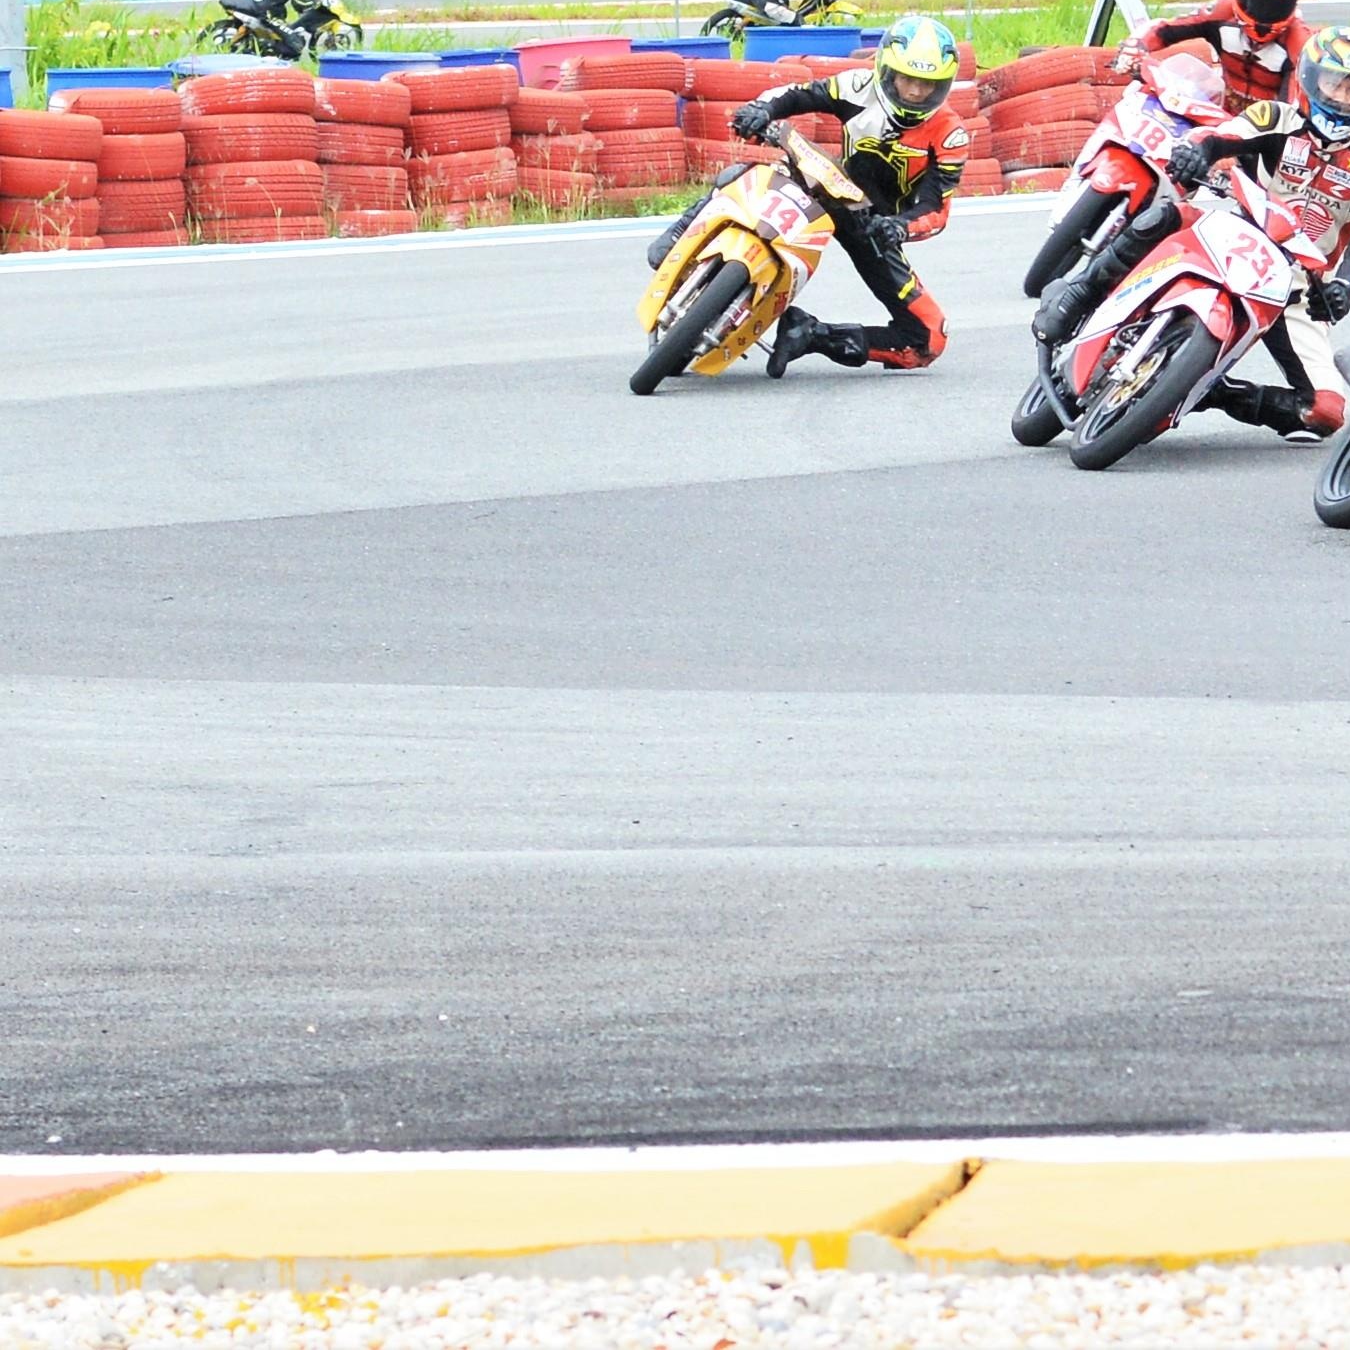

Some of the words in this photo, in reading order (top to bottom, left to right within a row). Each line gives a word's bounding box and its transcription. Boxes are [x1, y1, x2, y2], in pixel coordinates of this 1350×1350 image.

[1131, 120, 1166, 152] 18
[1281, 164, 1309, 177] KYT
[1279, 179, 1341, 210] HONDA
[761, 196, 800, 235] 14
[1228, 233, 1275, 278] 23
